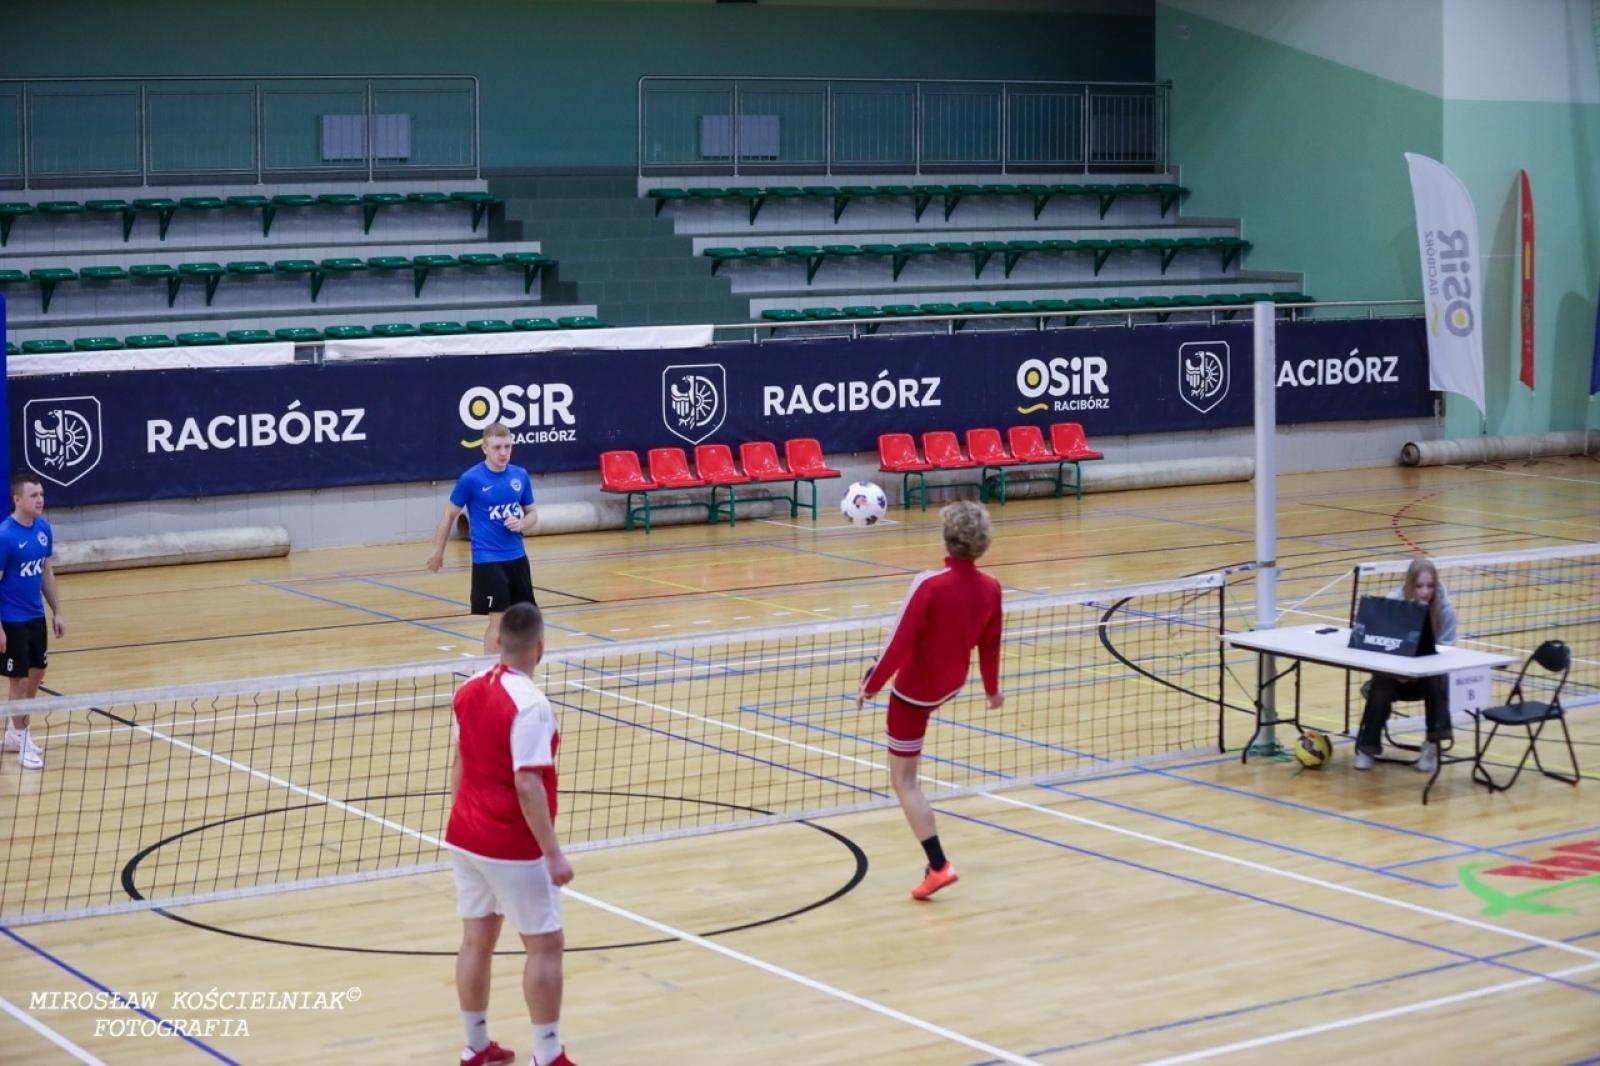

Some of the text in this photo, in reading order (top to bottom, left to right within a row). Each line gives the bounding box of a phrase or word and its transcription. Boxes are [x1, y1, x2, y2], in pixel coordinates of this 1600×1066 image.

[1016, 356, 1109, 398] OSiR
[1274, 348, 1399, 387] ACIBÓRZ
[459, 383, 576, 430] OSiR
[763, 369, 941, 416] RACIBÓRZ
[1054, 396, 1109, 411] RACIBÓRZ
[147, 400, 367, 453] RACIBÓRZ
[20, 558, 45, 577] KK
[486, 596, 493, 608] 7
[7, 658, 13, 671] 6
